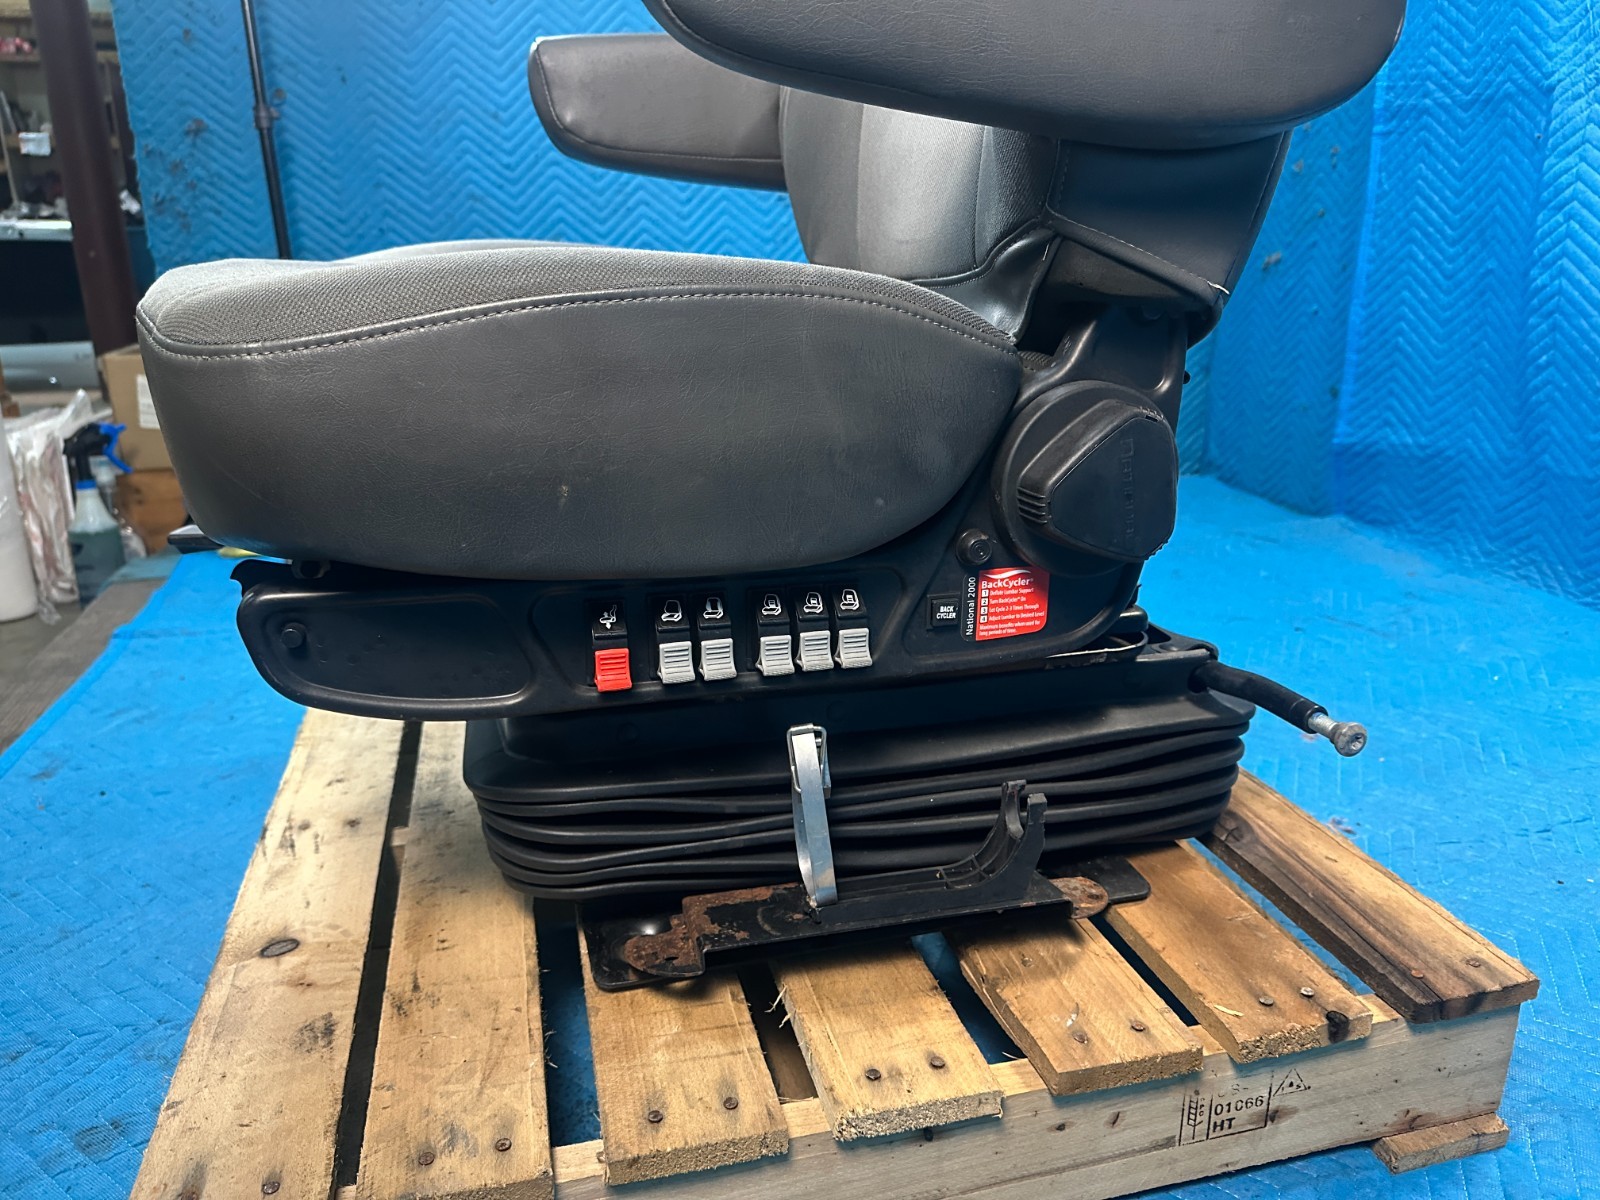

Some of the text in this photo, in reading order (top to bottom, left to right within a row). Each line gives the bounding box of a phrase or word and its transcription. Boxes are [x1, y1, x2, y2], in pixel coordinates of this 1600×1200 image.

[966, 577, 976, 636] National 2000
[1212, 1117, 1236, 1133] HT
